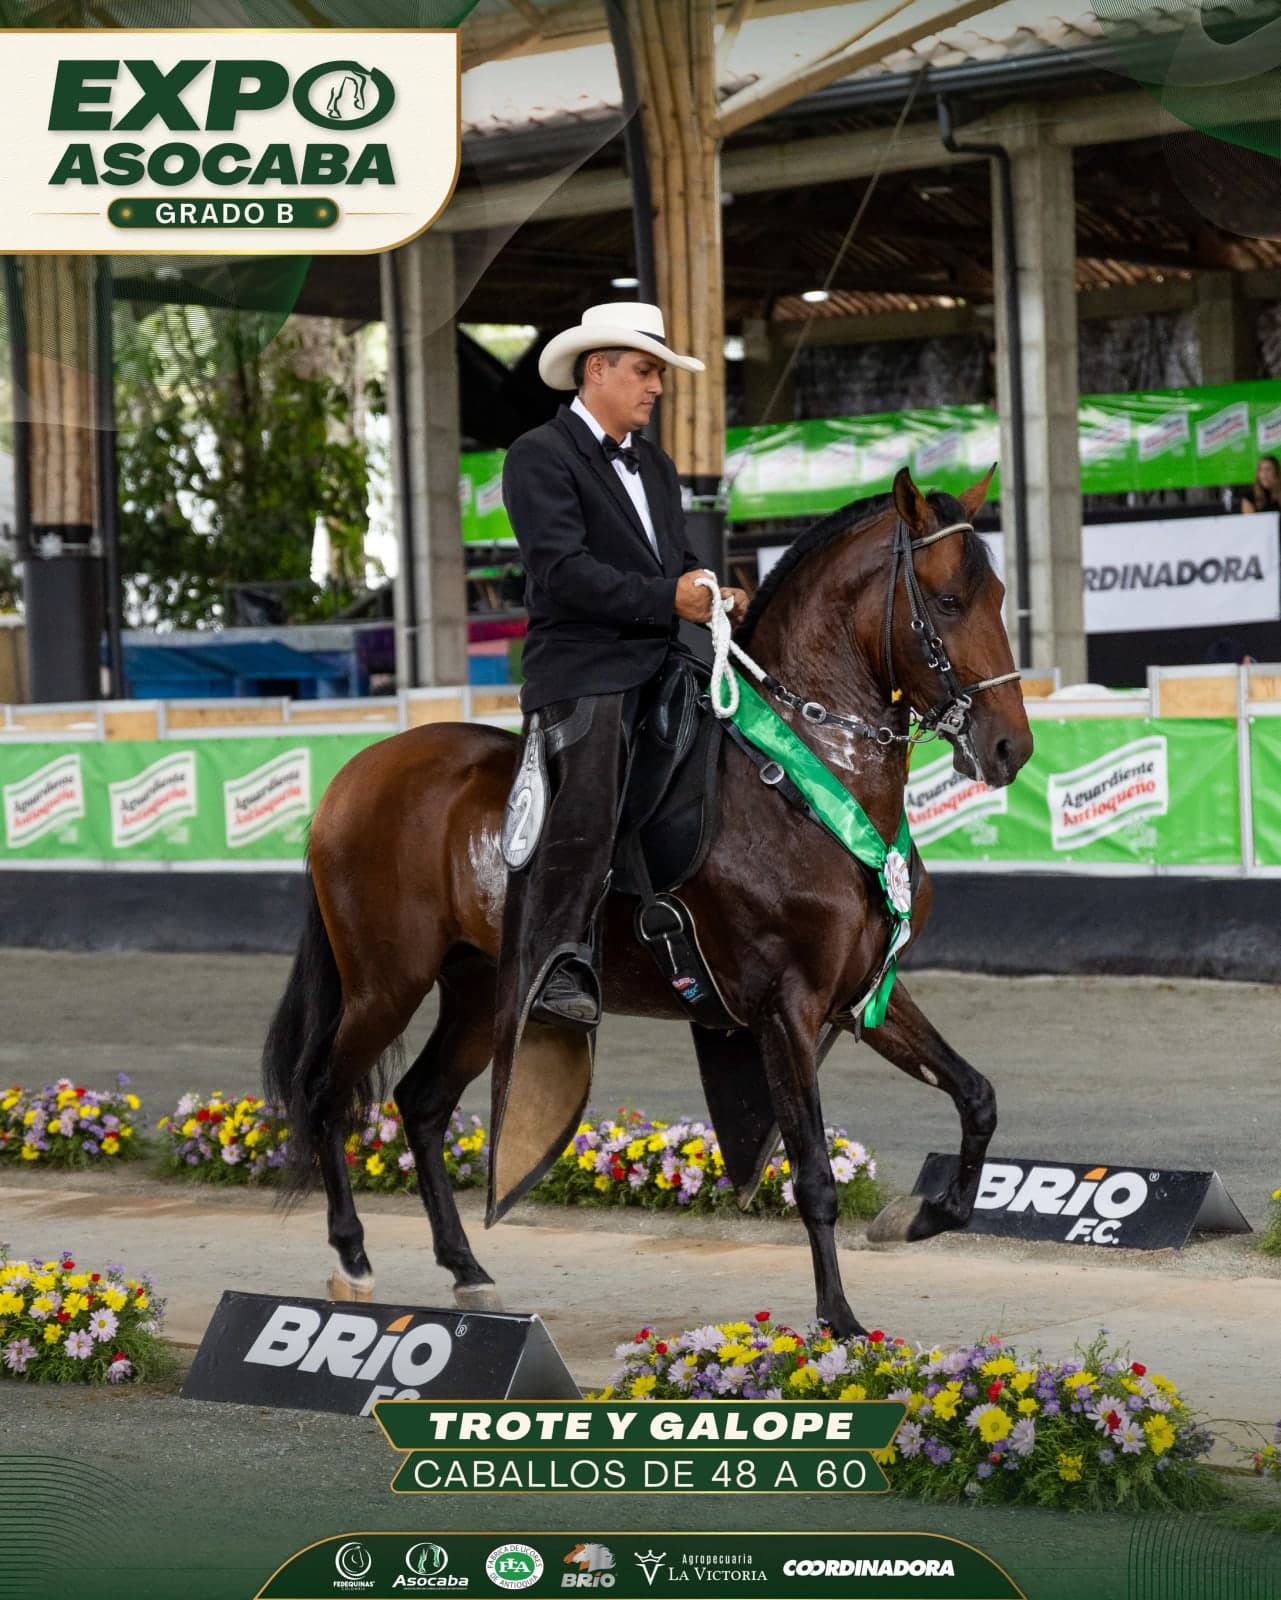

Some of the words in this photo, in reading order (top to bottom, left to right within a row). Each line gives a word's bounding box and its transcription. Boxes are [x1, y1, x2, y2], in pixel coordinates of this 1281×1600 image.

[1082, 555, 1265, 592] RDINADORA
[1062, 761, 1154, 808] Aguardiente
[509, 787, 532, 851] 2
